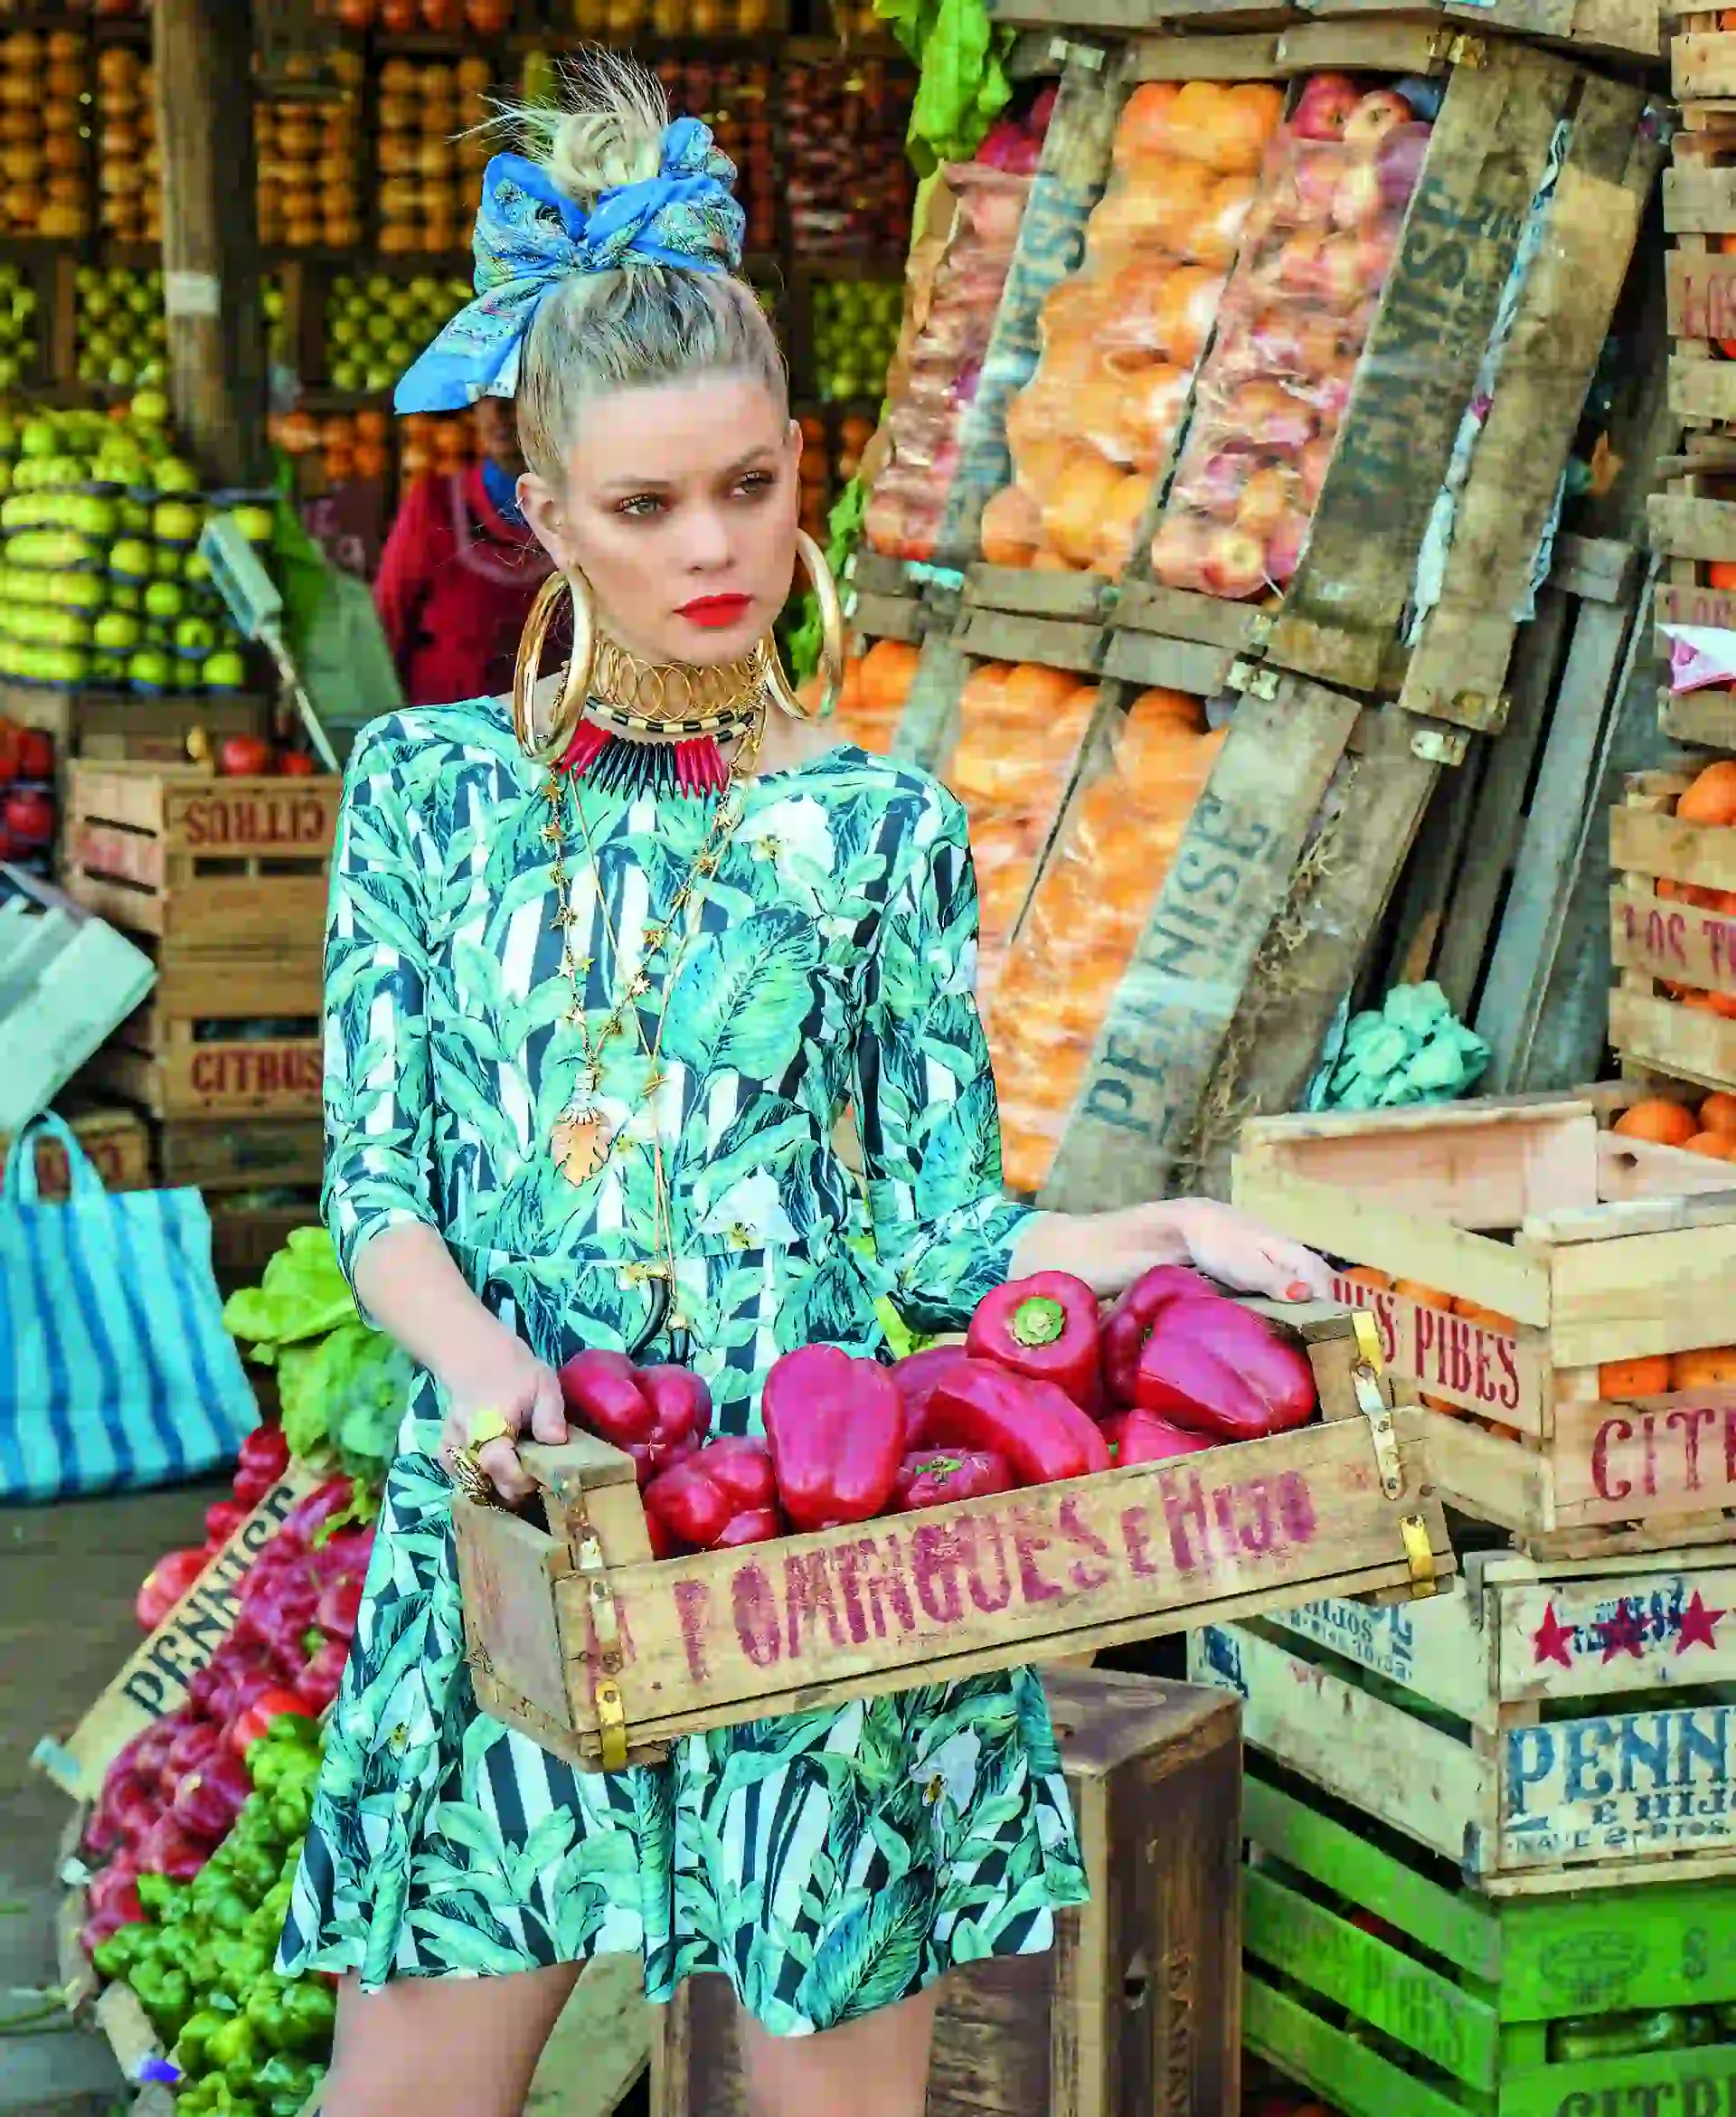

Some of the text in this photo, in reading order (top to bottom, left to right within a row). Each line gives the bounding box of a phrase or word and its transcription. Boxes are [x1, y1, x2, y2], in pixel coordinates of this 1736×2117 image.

[184, 800, 325, 845] CITRUS
[192, 1048, 323, 1093] CITRUS
[1414, 1304, 1520, 1411] PIBES
[1590, 1406, 1736, 1502] CIT
[1508, 1708, 1736, 1817] PENN
[1635, 1788, 1736, 1822] HIJ
